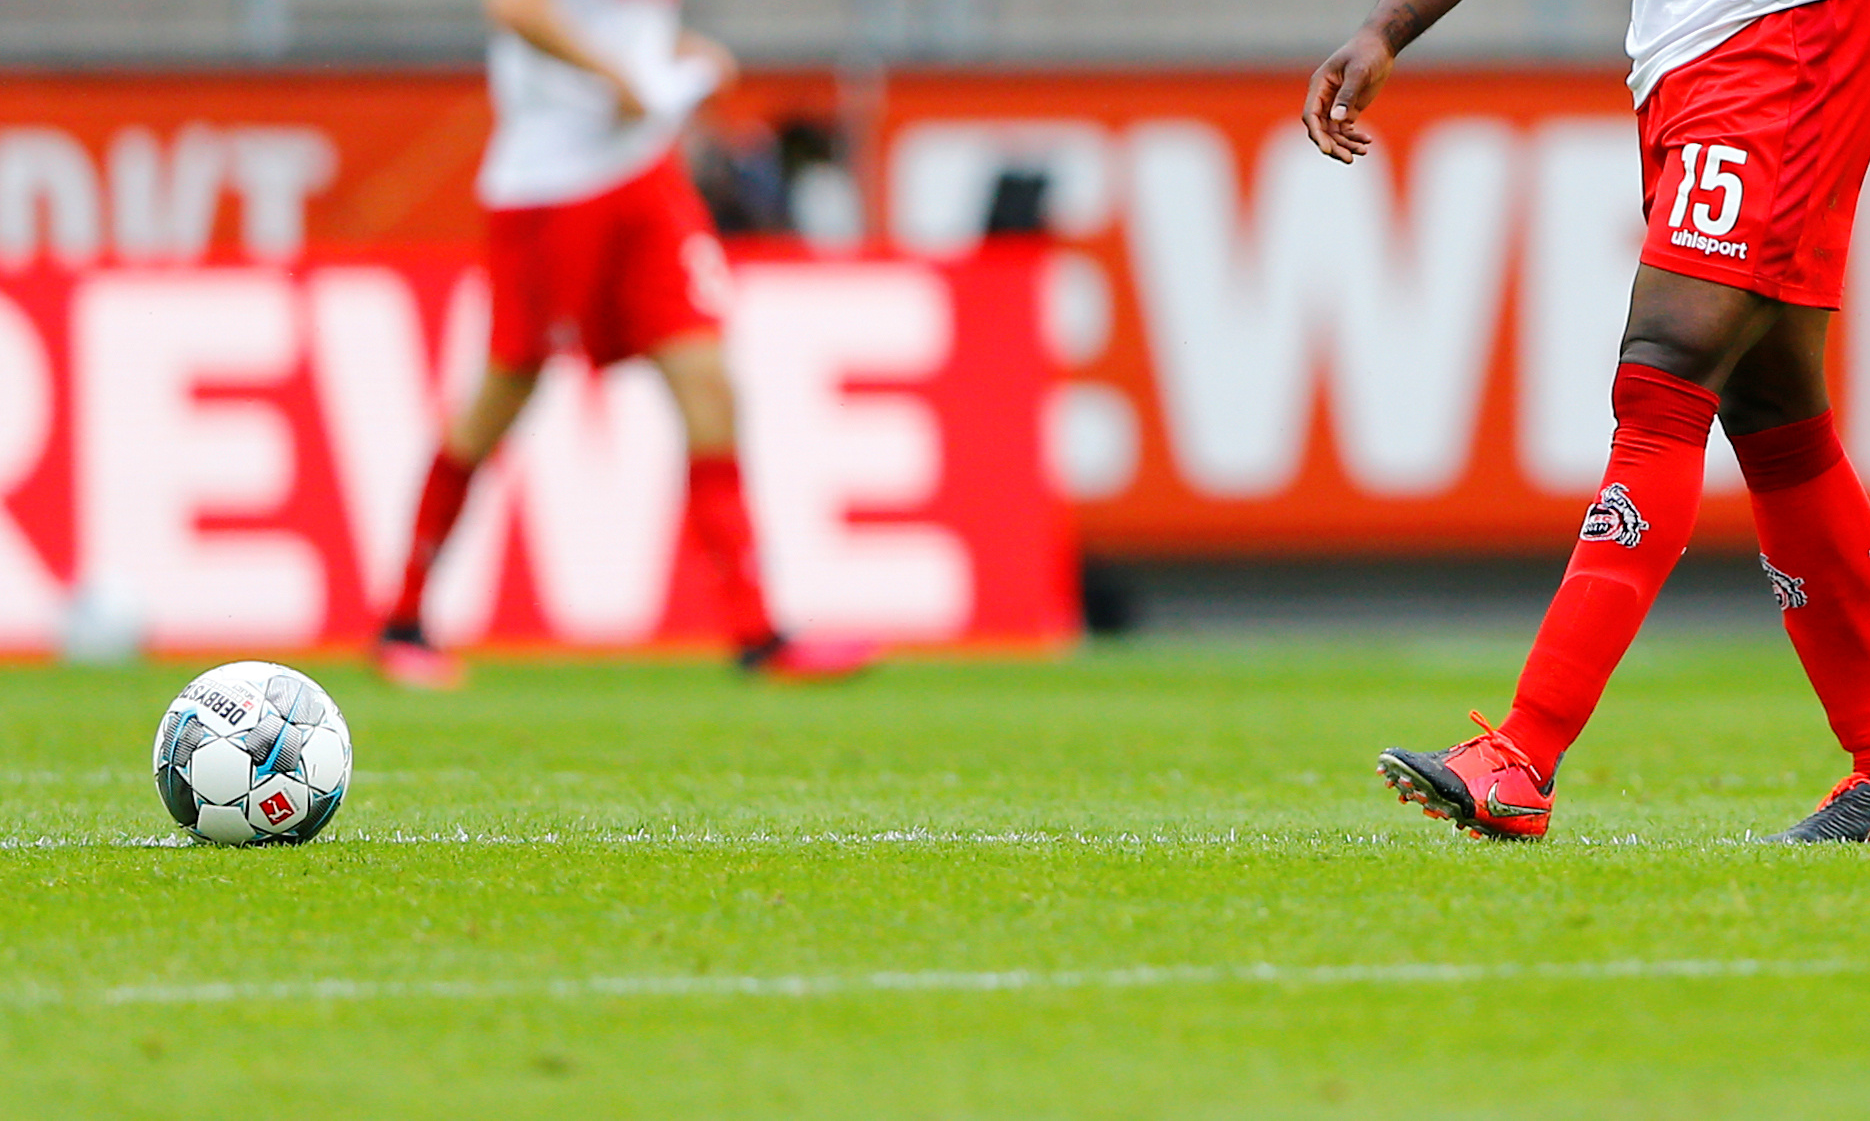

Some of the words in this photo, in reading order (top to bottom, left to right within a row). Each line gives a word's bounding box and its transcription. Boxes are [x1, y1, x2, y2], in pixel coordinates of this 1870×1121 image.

[1667, 142, 1748, 236] 15
[1670, 229, 1748, 260] uhlsport
[0, 261, 978, 647] EWE
